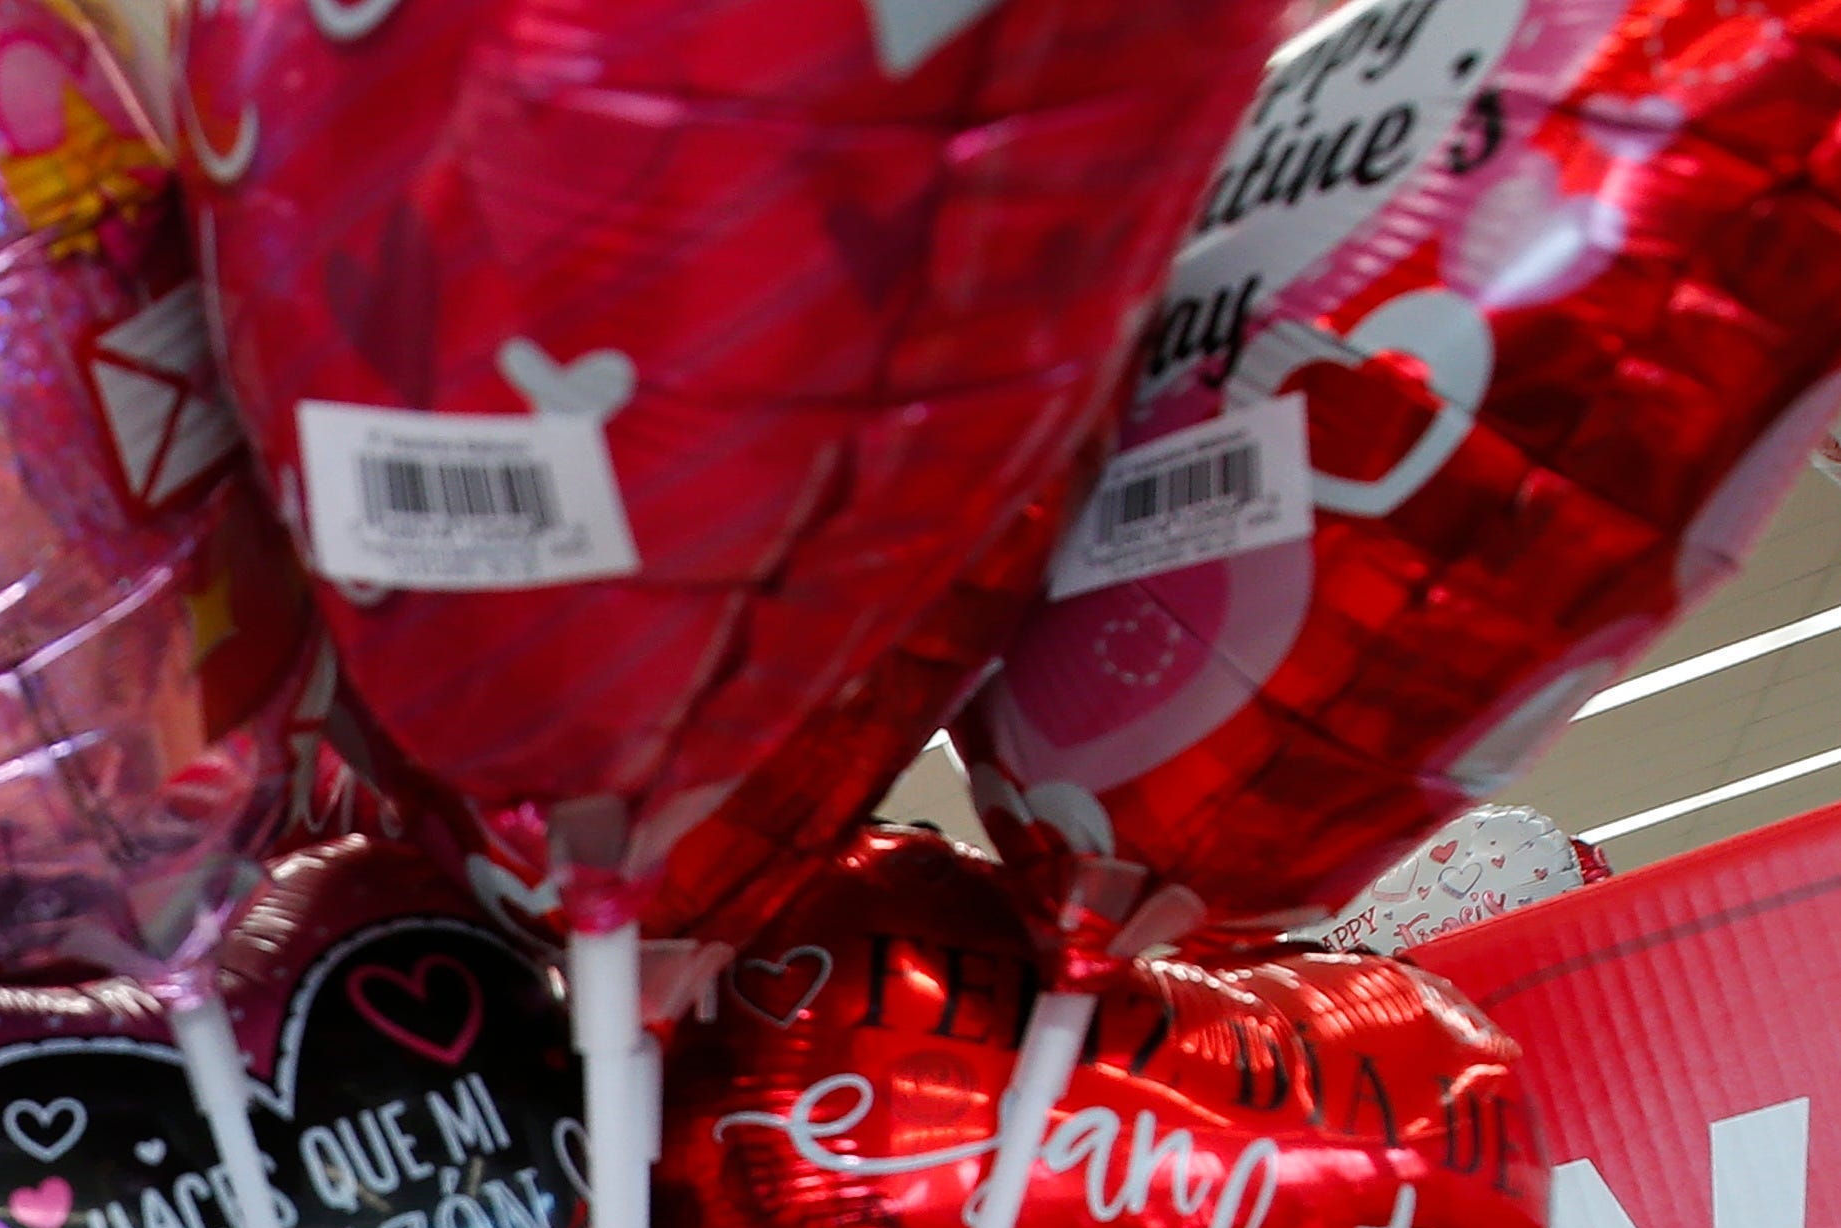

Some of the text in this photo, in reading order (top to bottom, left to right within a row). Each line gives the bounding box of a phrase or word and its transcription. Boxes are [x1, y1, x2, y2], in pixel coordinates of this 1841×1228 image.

[1149, 274, 1262, 389] ay
[1319, 906, 1377, 953] APPY
[299, 1101, 435, 1211] QUE
[426, 1073, 511, 1164] MI
